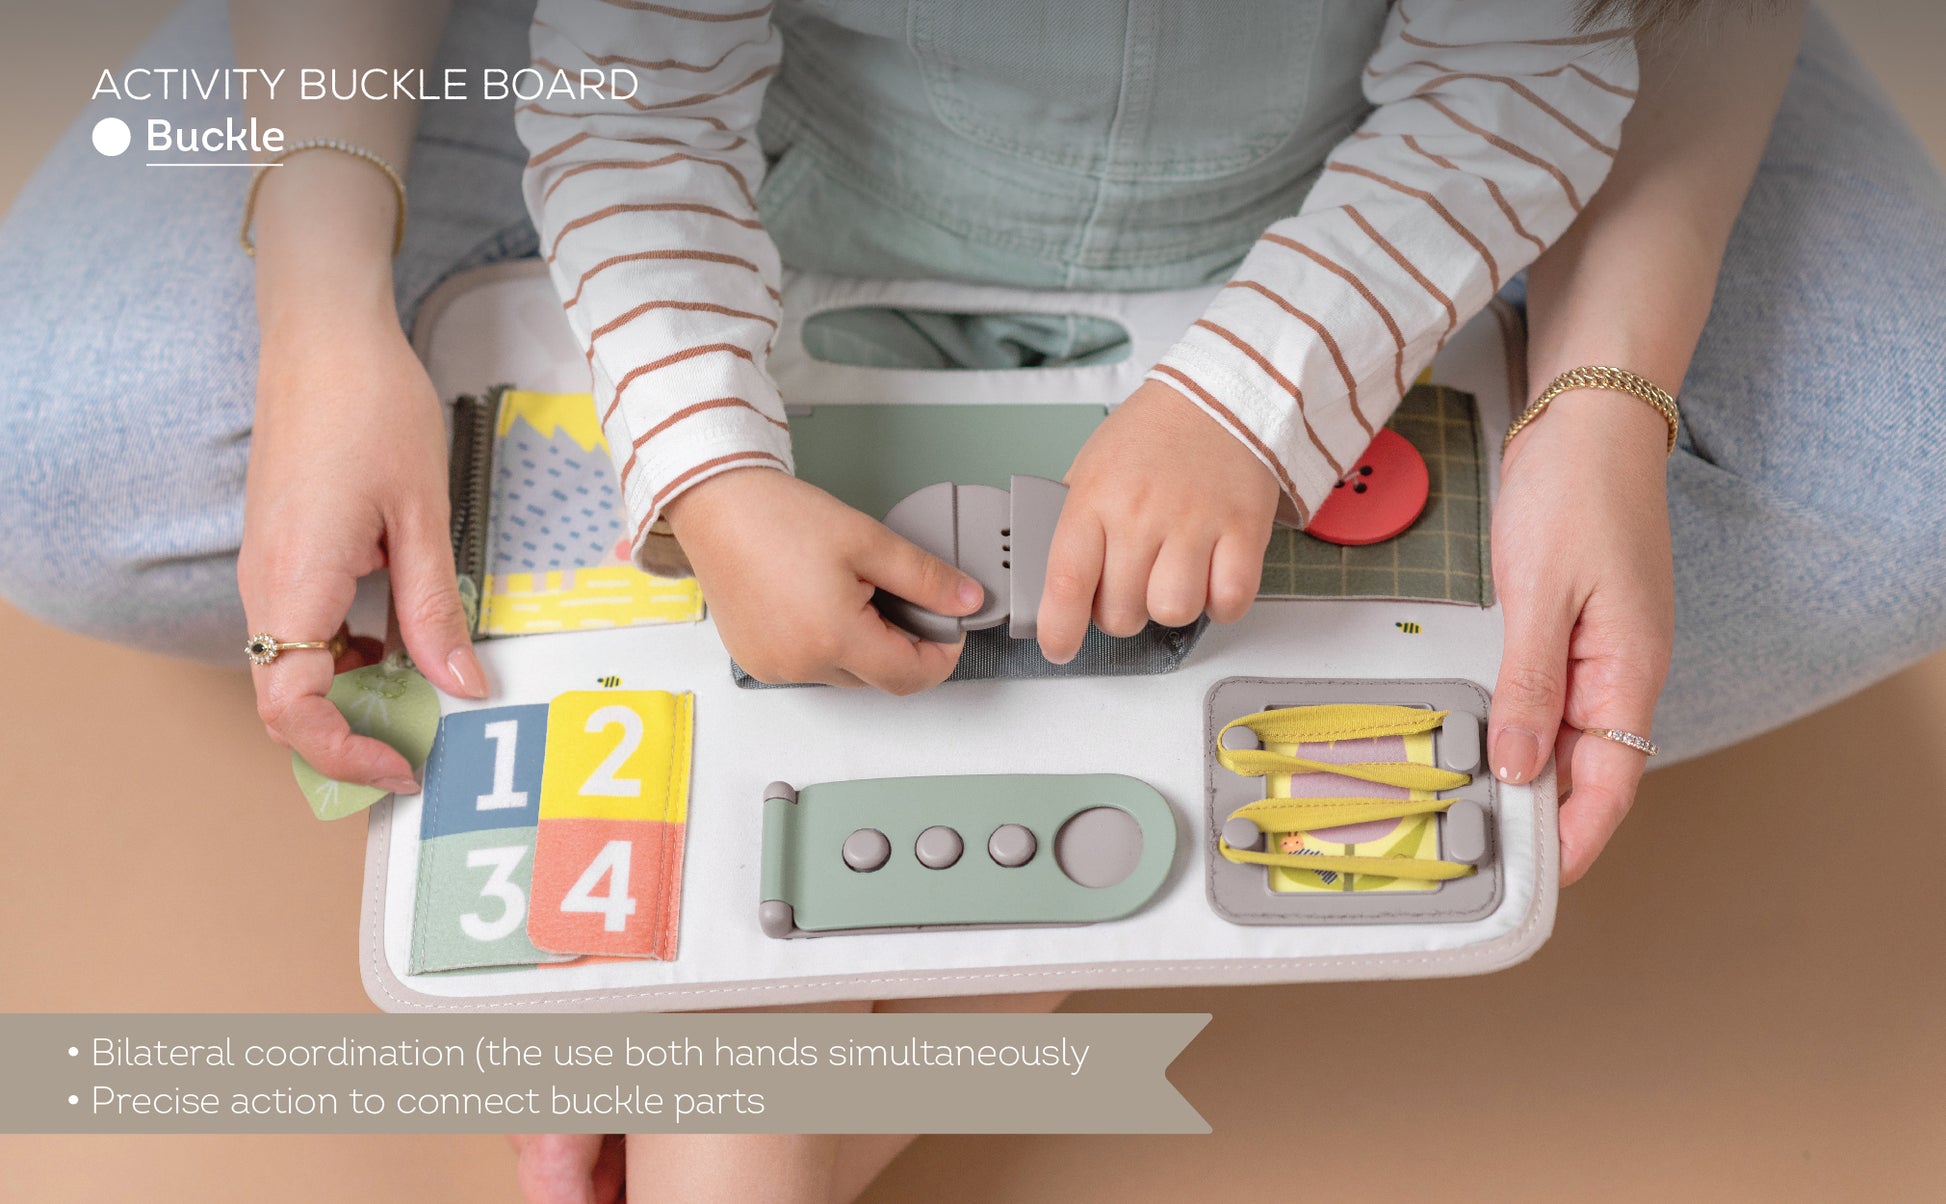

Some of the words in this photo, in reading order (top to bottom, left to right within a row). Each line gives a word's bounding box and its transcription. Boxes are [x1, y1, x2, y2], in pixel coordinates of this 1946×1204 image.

[476, 719, 528, 811] 1
[578, 705, 644, 797] 2
[459, 845, 529, 941] 3
[560, 840, 636, 932] 4
